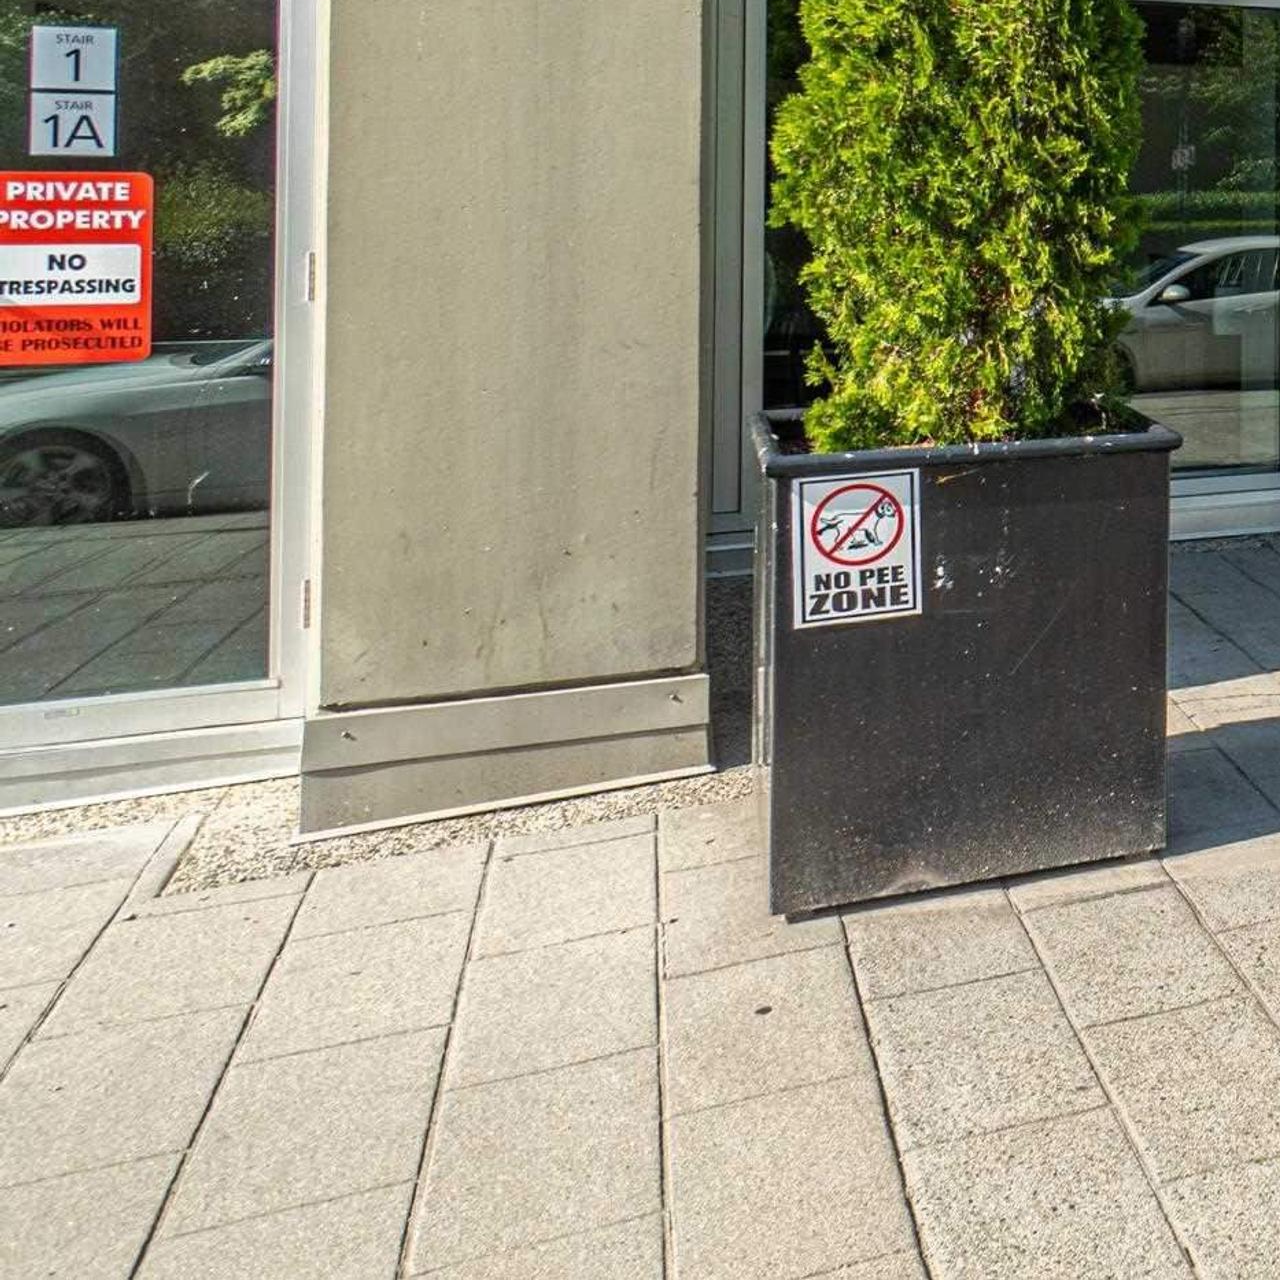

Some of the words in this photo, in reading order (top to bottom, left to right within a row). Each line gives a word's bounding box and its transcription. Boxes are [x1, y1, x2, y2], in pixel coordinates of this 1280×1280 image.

[56, 33, 95, 45] STAIR
[65, 48, 81, 82] 1
[55, 100, 94, 111] STAIR
[42, 114, 104, 149] 1A
[6, 181, 131, 202] PRIVATE
[48, 253, 87, 272] NO
[0, 278, 136, 295] TRESPASSING
[0, 318, 93, 334] IOLATORS
[99, 317, 143, 331] WILL
[22, 335, 143, 352] PROSECUTED
[814, 572, 850, 592] NO
[859, 565, 904, 586] PEE
[809, 584, 909, 616] ZONE
